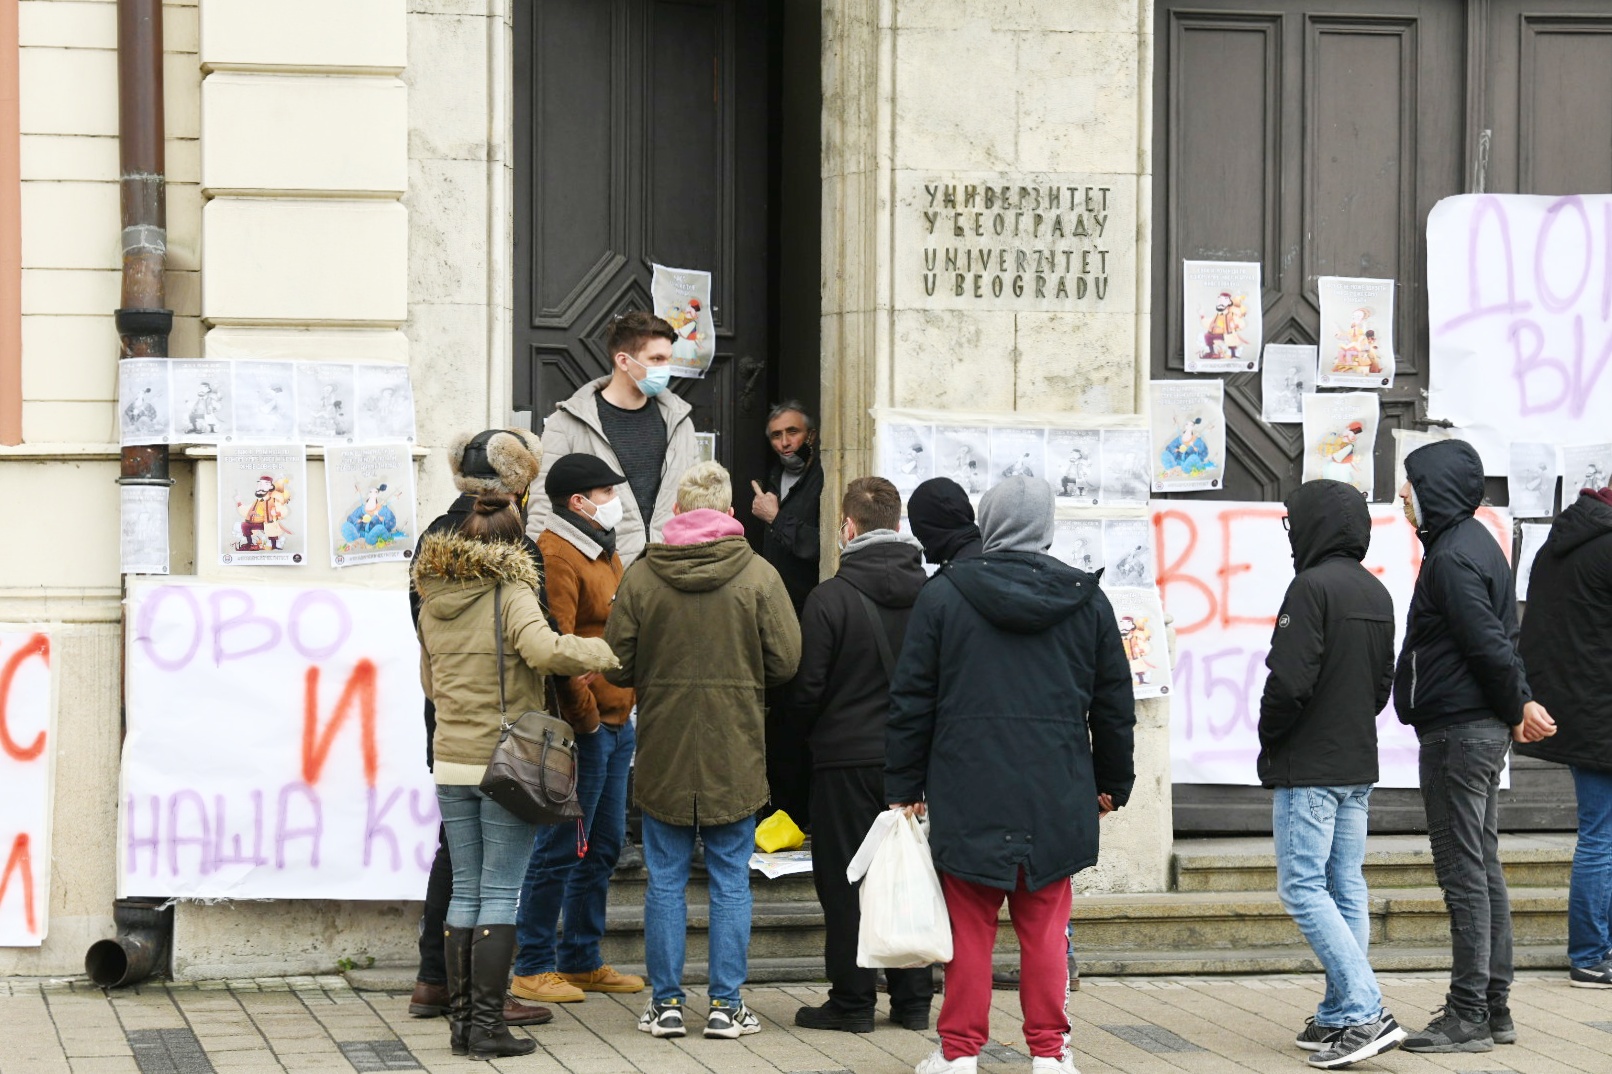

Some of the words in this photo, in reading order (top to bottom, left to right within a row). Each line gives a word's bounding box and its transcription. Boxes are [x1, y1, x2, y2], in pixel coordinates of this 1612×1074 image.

[924, 184, 1111, 211] УНИВЕРЗИТЕТ
[924, 211, 939, 235] У
[953, 212, 1108, 238] БЕОГРАДУ
[924, 248, 1110, 274] UNIVERZITET
[923, 273, 937, 297] U
[955, 273, 1108, 300] BEOGRADU
[137, 584, 353, 671] ОВО
[127, 781, 323, 878] НАША
